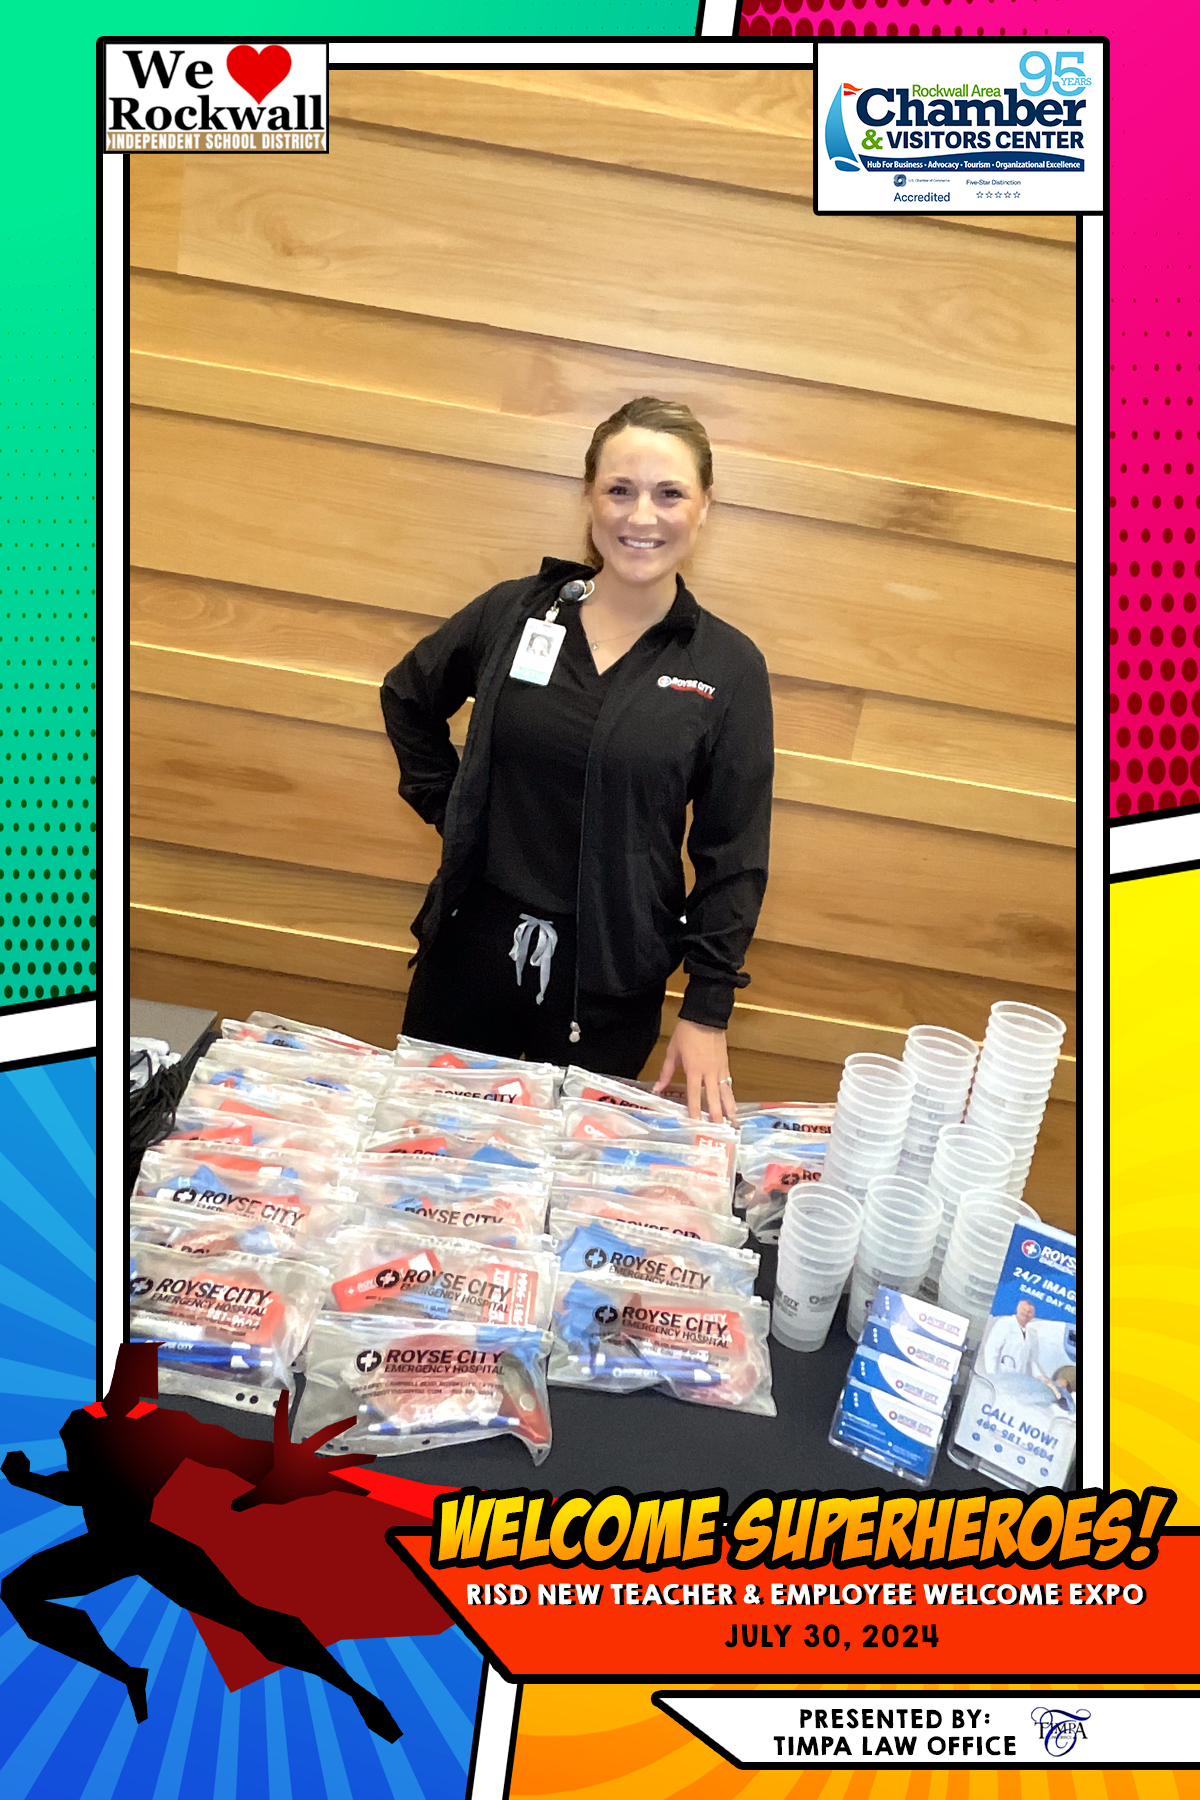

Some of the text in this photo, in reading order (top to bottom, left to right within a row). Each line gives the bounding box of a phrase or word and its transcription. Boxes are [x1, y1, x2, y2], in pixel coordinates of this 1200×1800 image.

[199, 1189, 262, 1215] ROYSE
[261, 1204, 305, 1227] CITY
[610, 1251, 668, 1277] ROYSE
[670, 1266, 712, 1289] CITY
[1041, 1246, 1076, 1270] ROYS
[403, 1269, 513, 1301] ROYSE CITY
[1013, 1266, 1042, 1285] 24/7
[151, 1293, 267, 1317] EMERGENCY HOSPITAL
[155, 1278, 273, 1306] ROYSE CITY
[400, 1283, 461, 1301] EMERGENCY
[462, 1294, 510, 1314] HOSPITAL
[1020, 1284, 1046, 1301] SAME
[1045, 1295, 1065, 1308] DAY
[622, 1306, 683, 1328] ROYSE
[686, 1316, 729, 1338] CITY
[622, 1319, 681, 1337] EMERGENCY
[682, 1331, 730, 1349] HOSPITAL
[384, 1364, 506, 1376] EMERGENCY HOSPITAL
[386, 1350, 505, 1364] ROYSE CITY
[981, 1403, 1059, 1449] CALL NOW!
